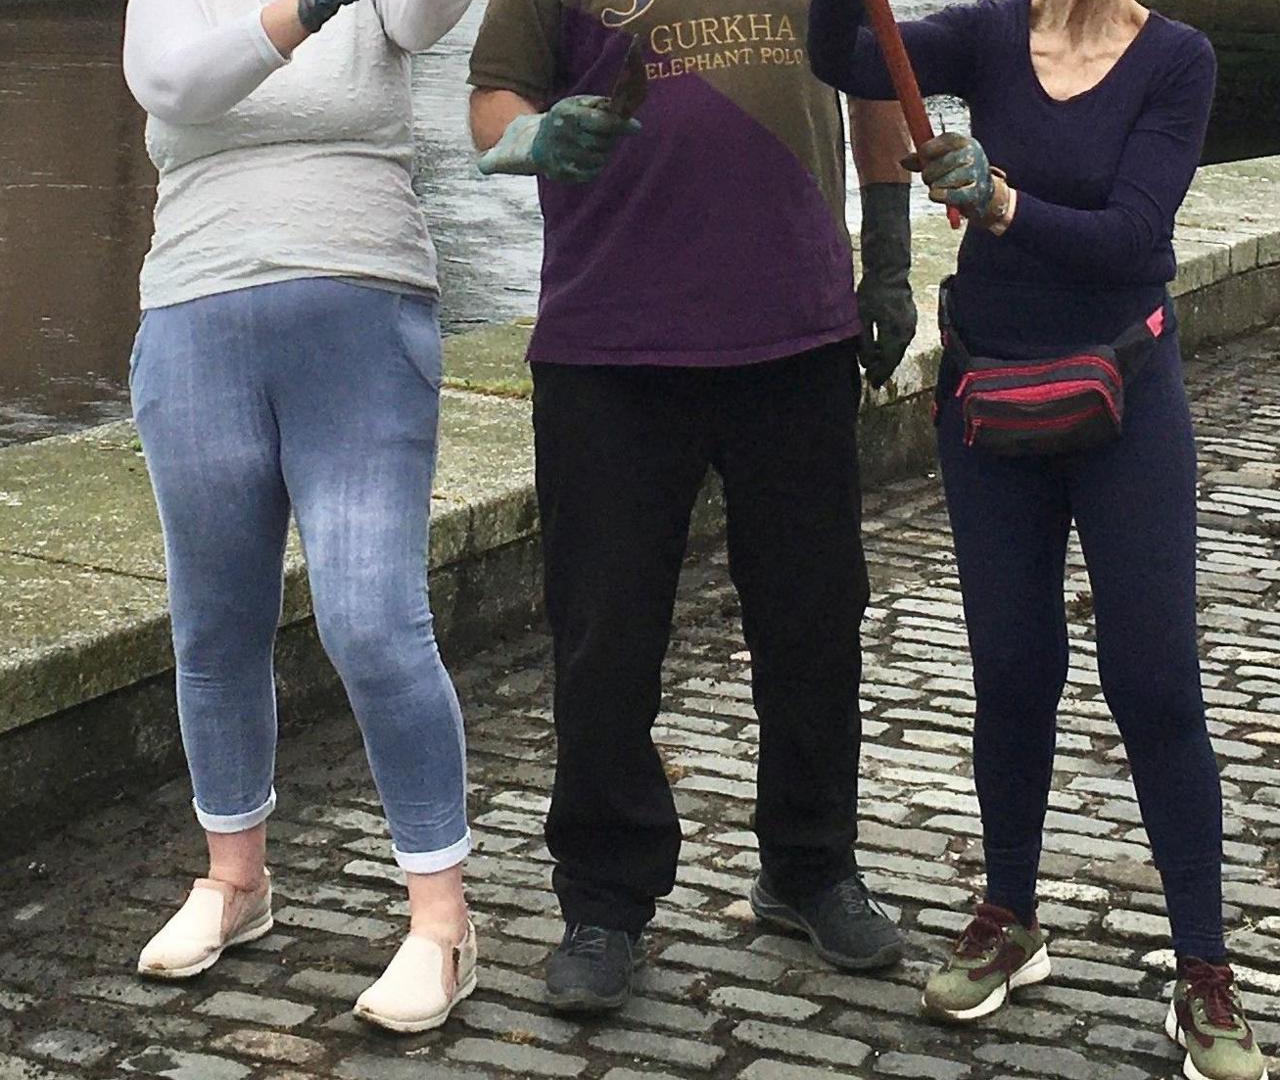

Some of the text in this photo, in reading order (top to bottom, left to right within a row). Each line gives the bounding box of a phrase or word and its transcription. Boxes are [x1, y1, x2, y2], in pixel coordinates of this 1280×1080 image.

[650, 13, 796, 55] GURKHA
[644, 48, 803, 80] ELEPHANT POLO
